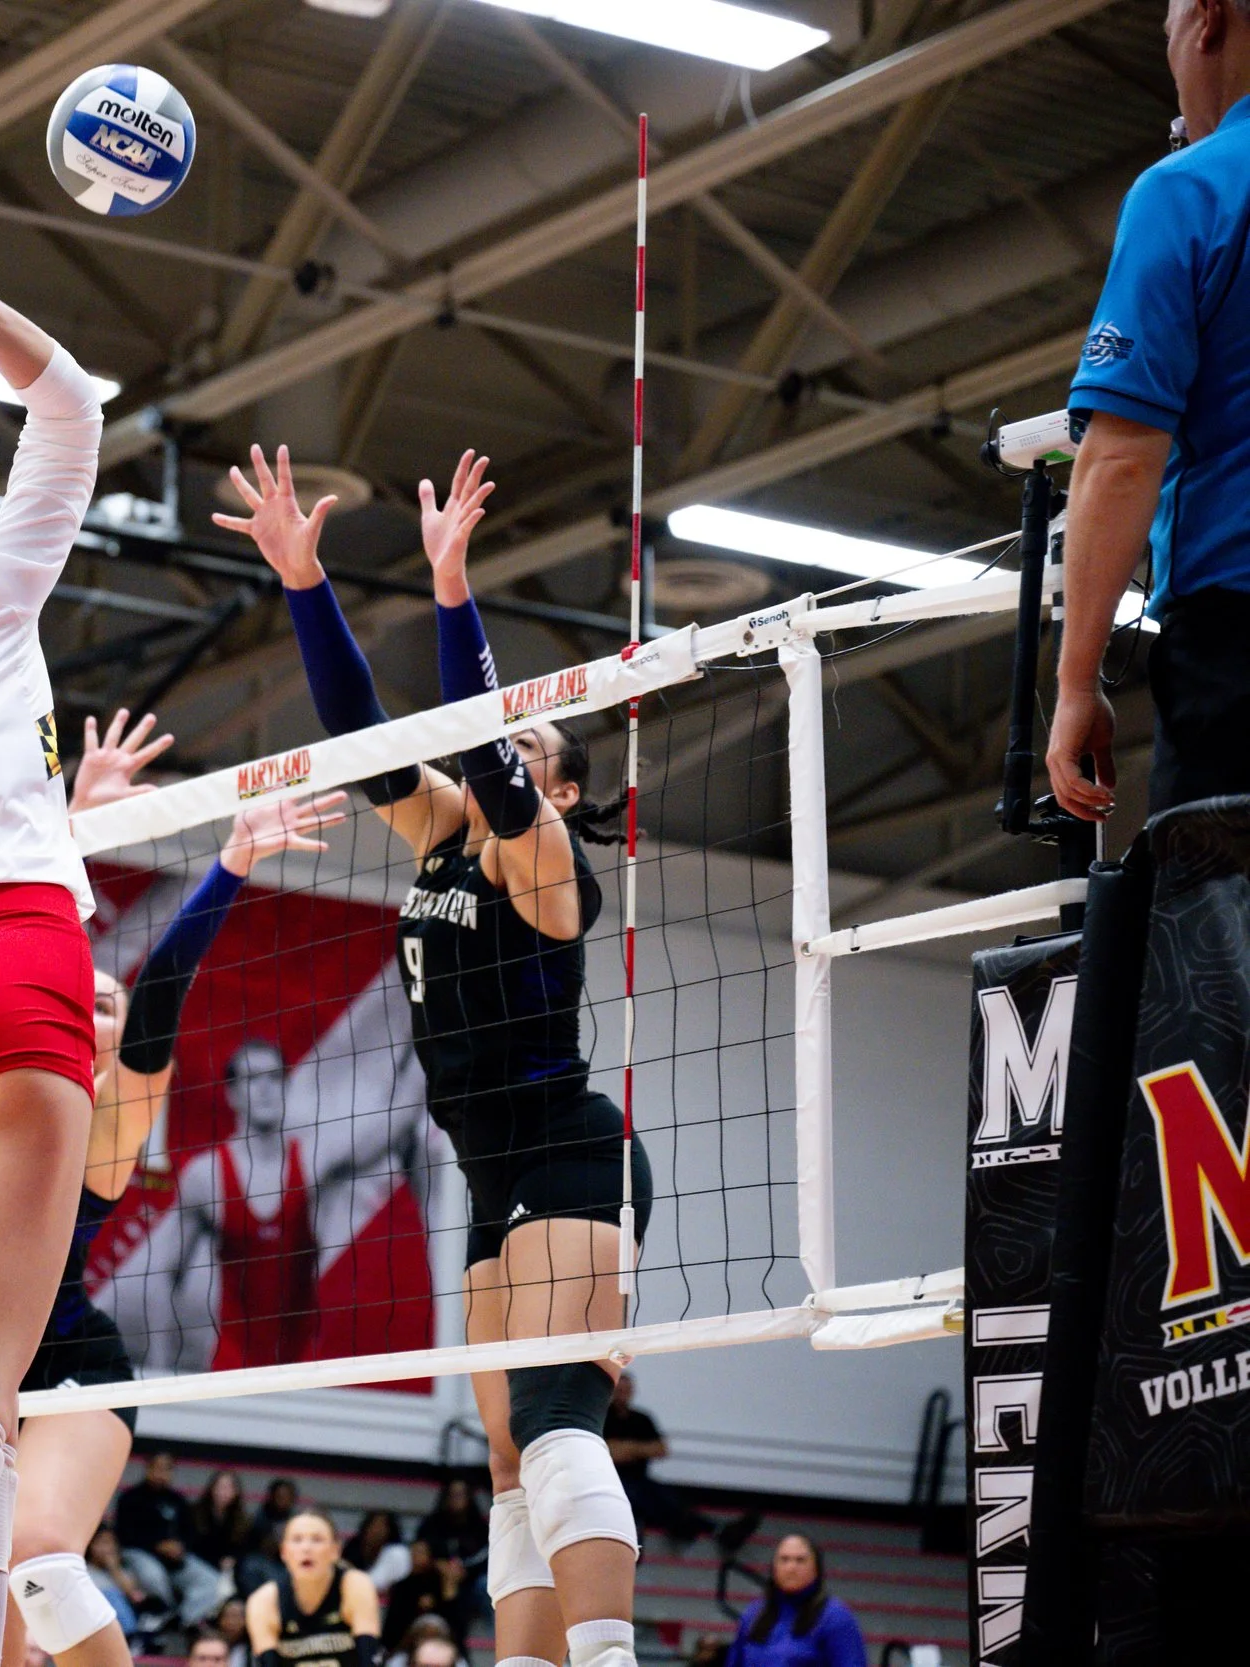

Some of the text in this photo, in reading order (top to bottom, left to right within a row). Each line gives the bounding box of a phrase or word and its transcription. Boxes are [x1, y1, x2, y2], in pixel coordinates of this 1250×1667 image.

[90, 124, 157, 172] NCAA
[97, 99, 173, 148] molten
[757, 609, 789, 627] Senoh
[503, 667, 587, 717] MARYLAND
[238, 749, 310, 793] MARYLAND
[403, 937, 425, 1003] 9
[973, 975, 1078, 1145] M
